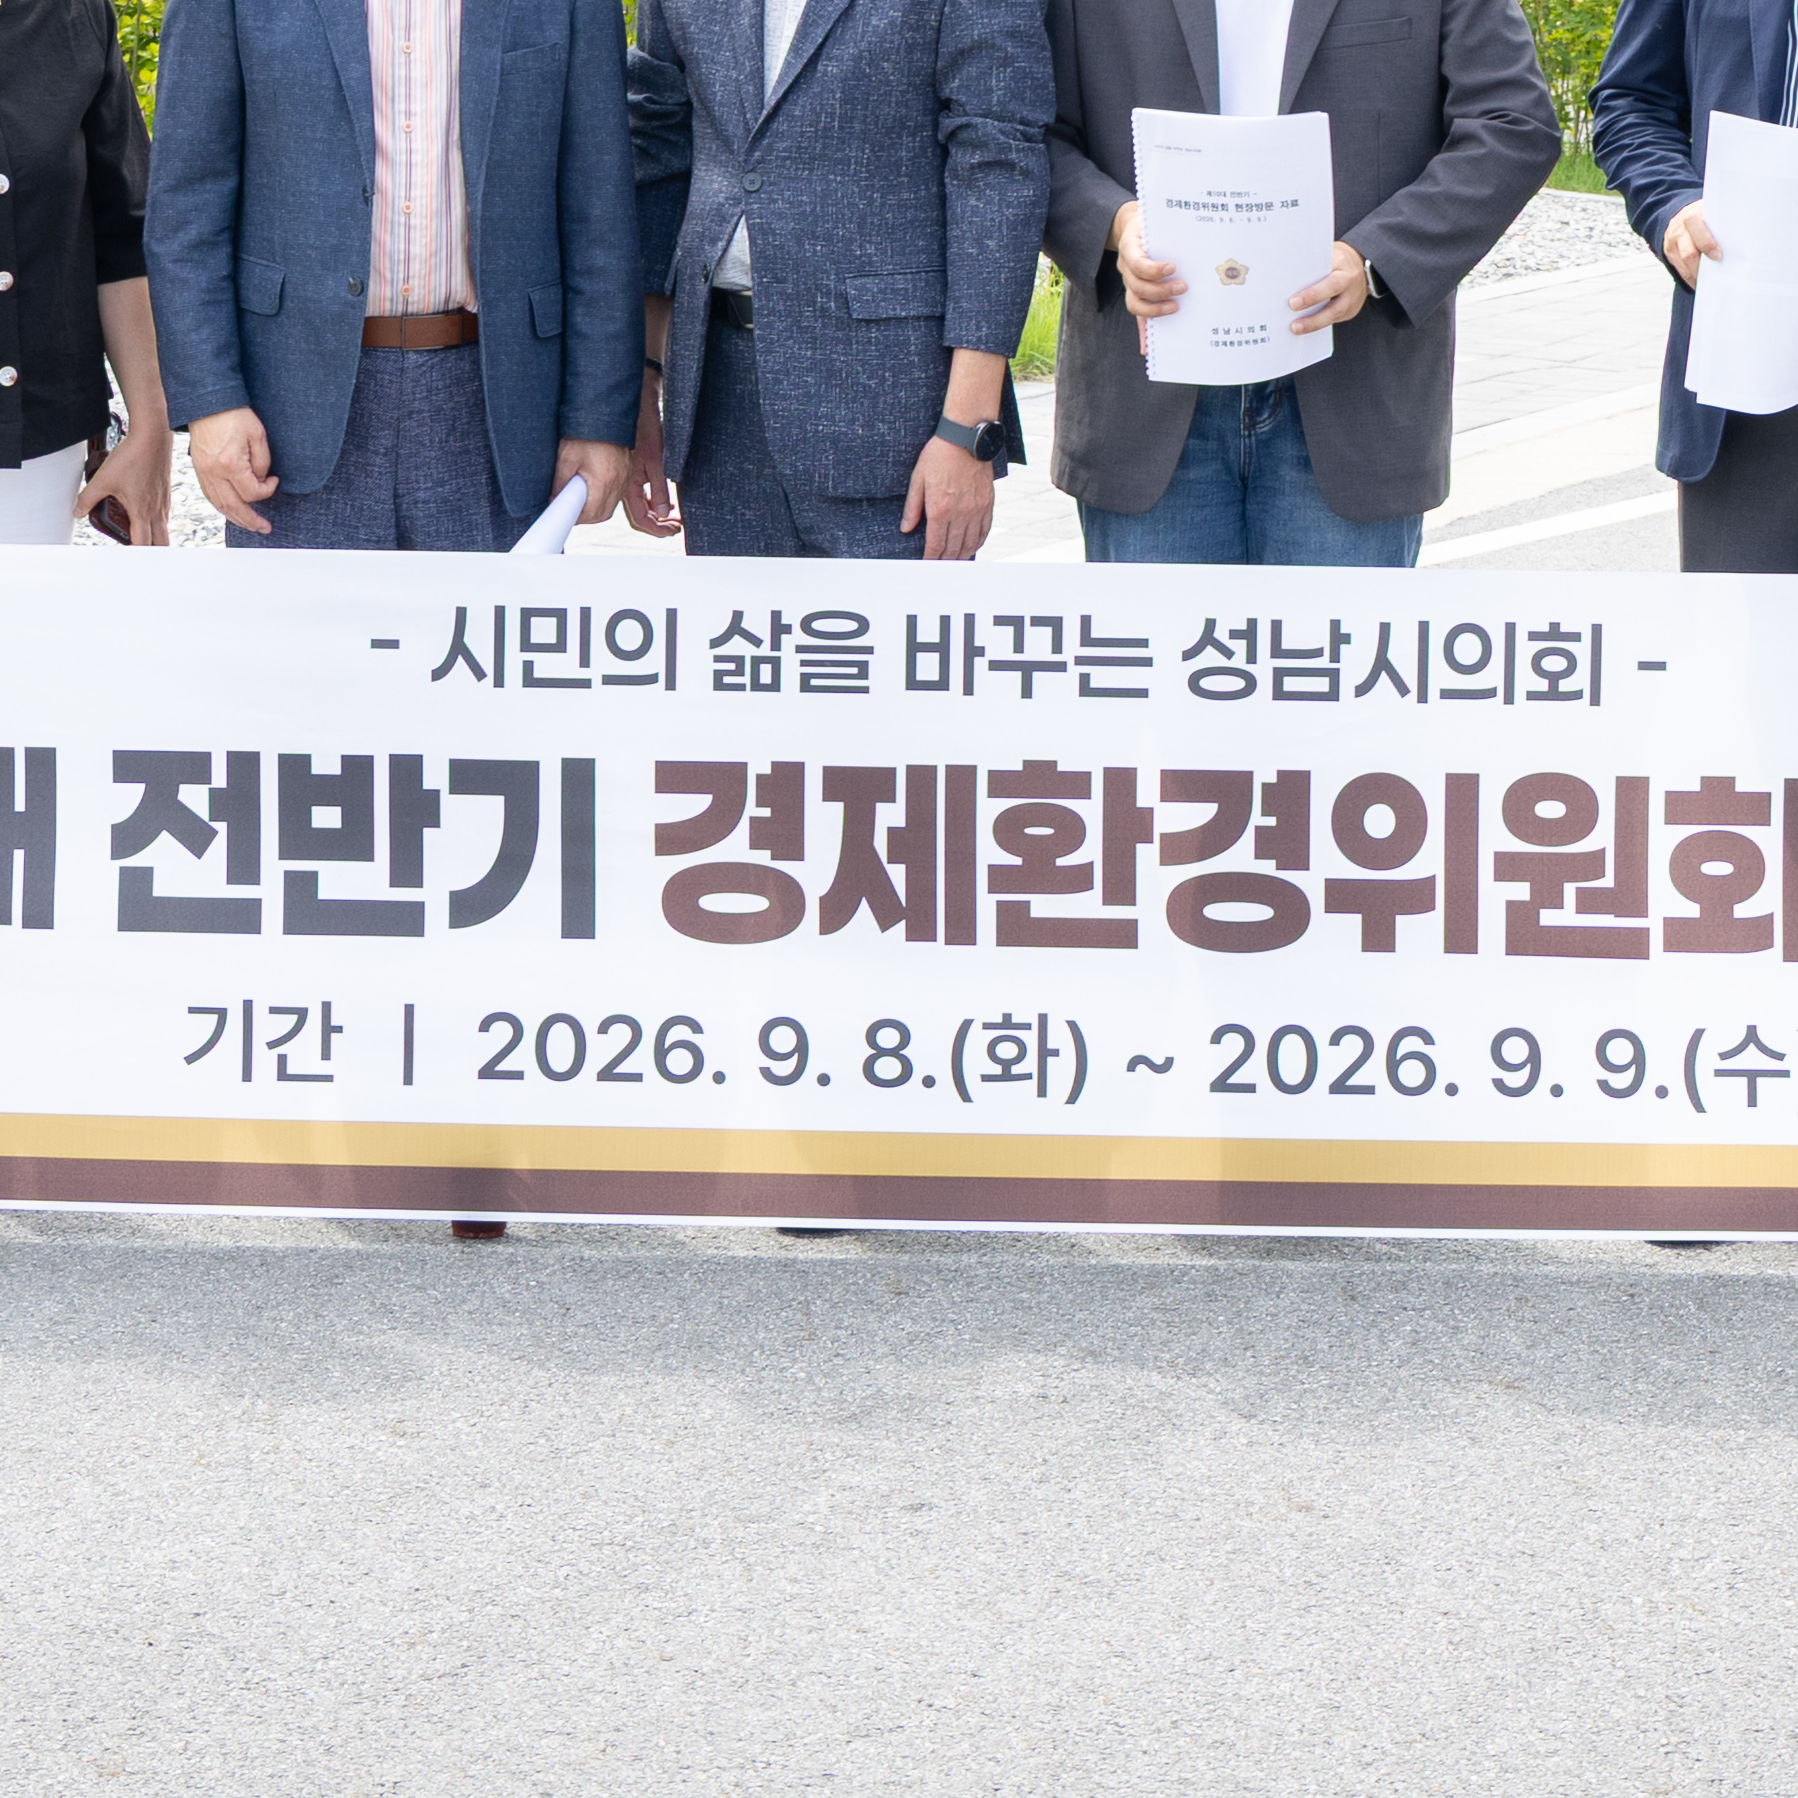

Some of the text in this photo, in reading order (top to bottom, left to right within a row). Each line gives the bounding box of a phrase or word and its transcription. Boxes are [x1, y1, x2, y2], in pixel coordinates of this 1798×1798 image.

[1165, 198, 1301, 213] 경제환경위원회 현장방문 자료
[430, 604, 678, 692] 시민의
[708, 609, 875, 695] 삶을
[904, 612, 1154, 700] 바꾸는
[1181, 617, 1603, 707] 성남시의회
[110, 749, 597, 940] 전반기
[183, 999, 344, 1083] 기간
[477, 1011, 727, 1085] 2026.
[758, 1016, 831, 1087] 9.
[1209, 1023, 1459, 1097] 2026.
[1490, 1027, 1564, 1098] 9.
